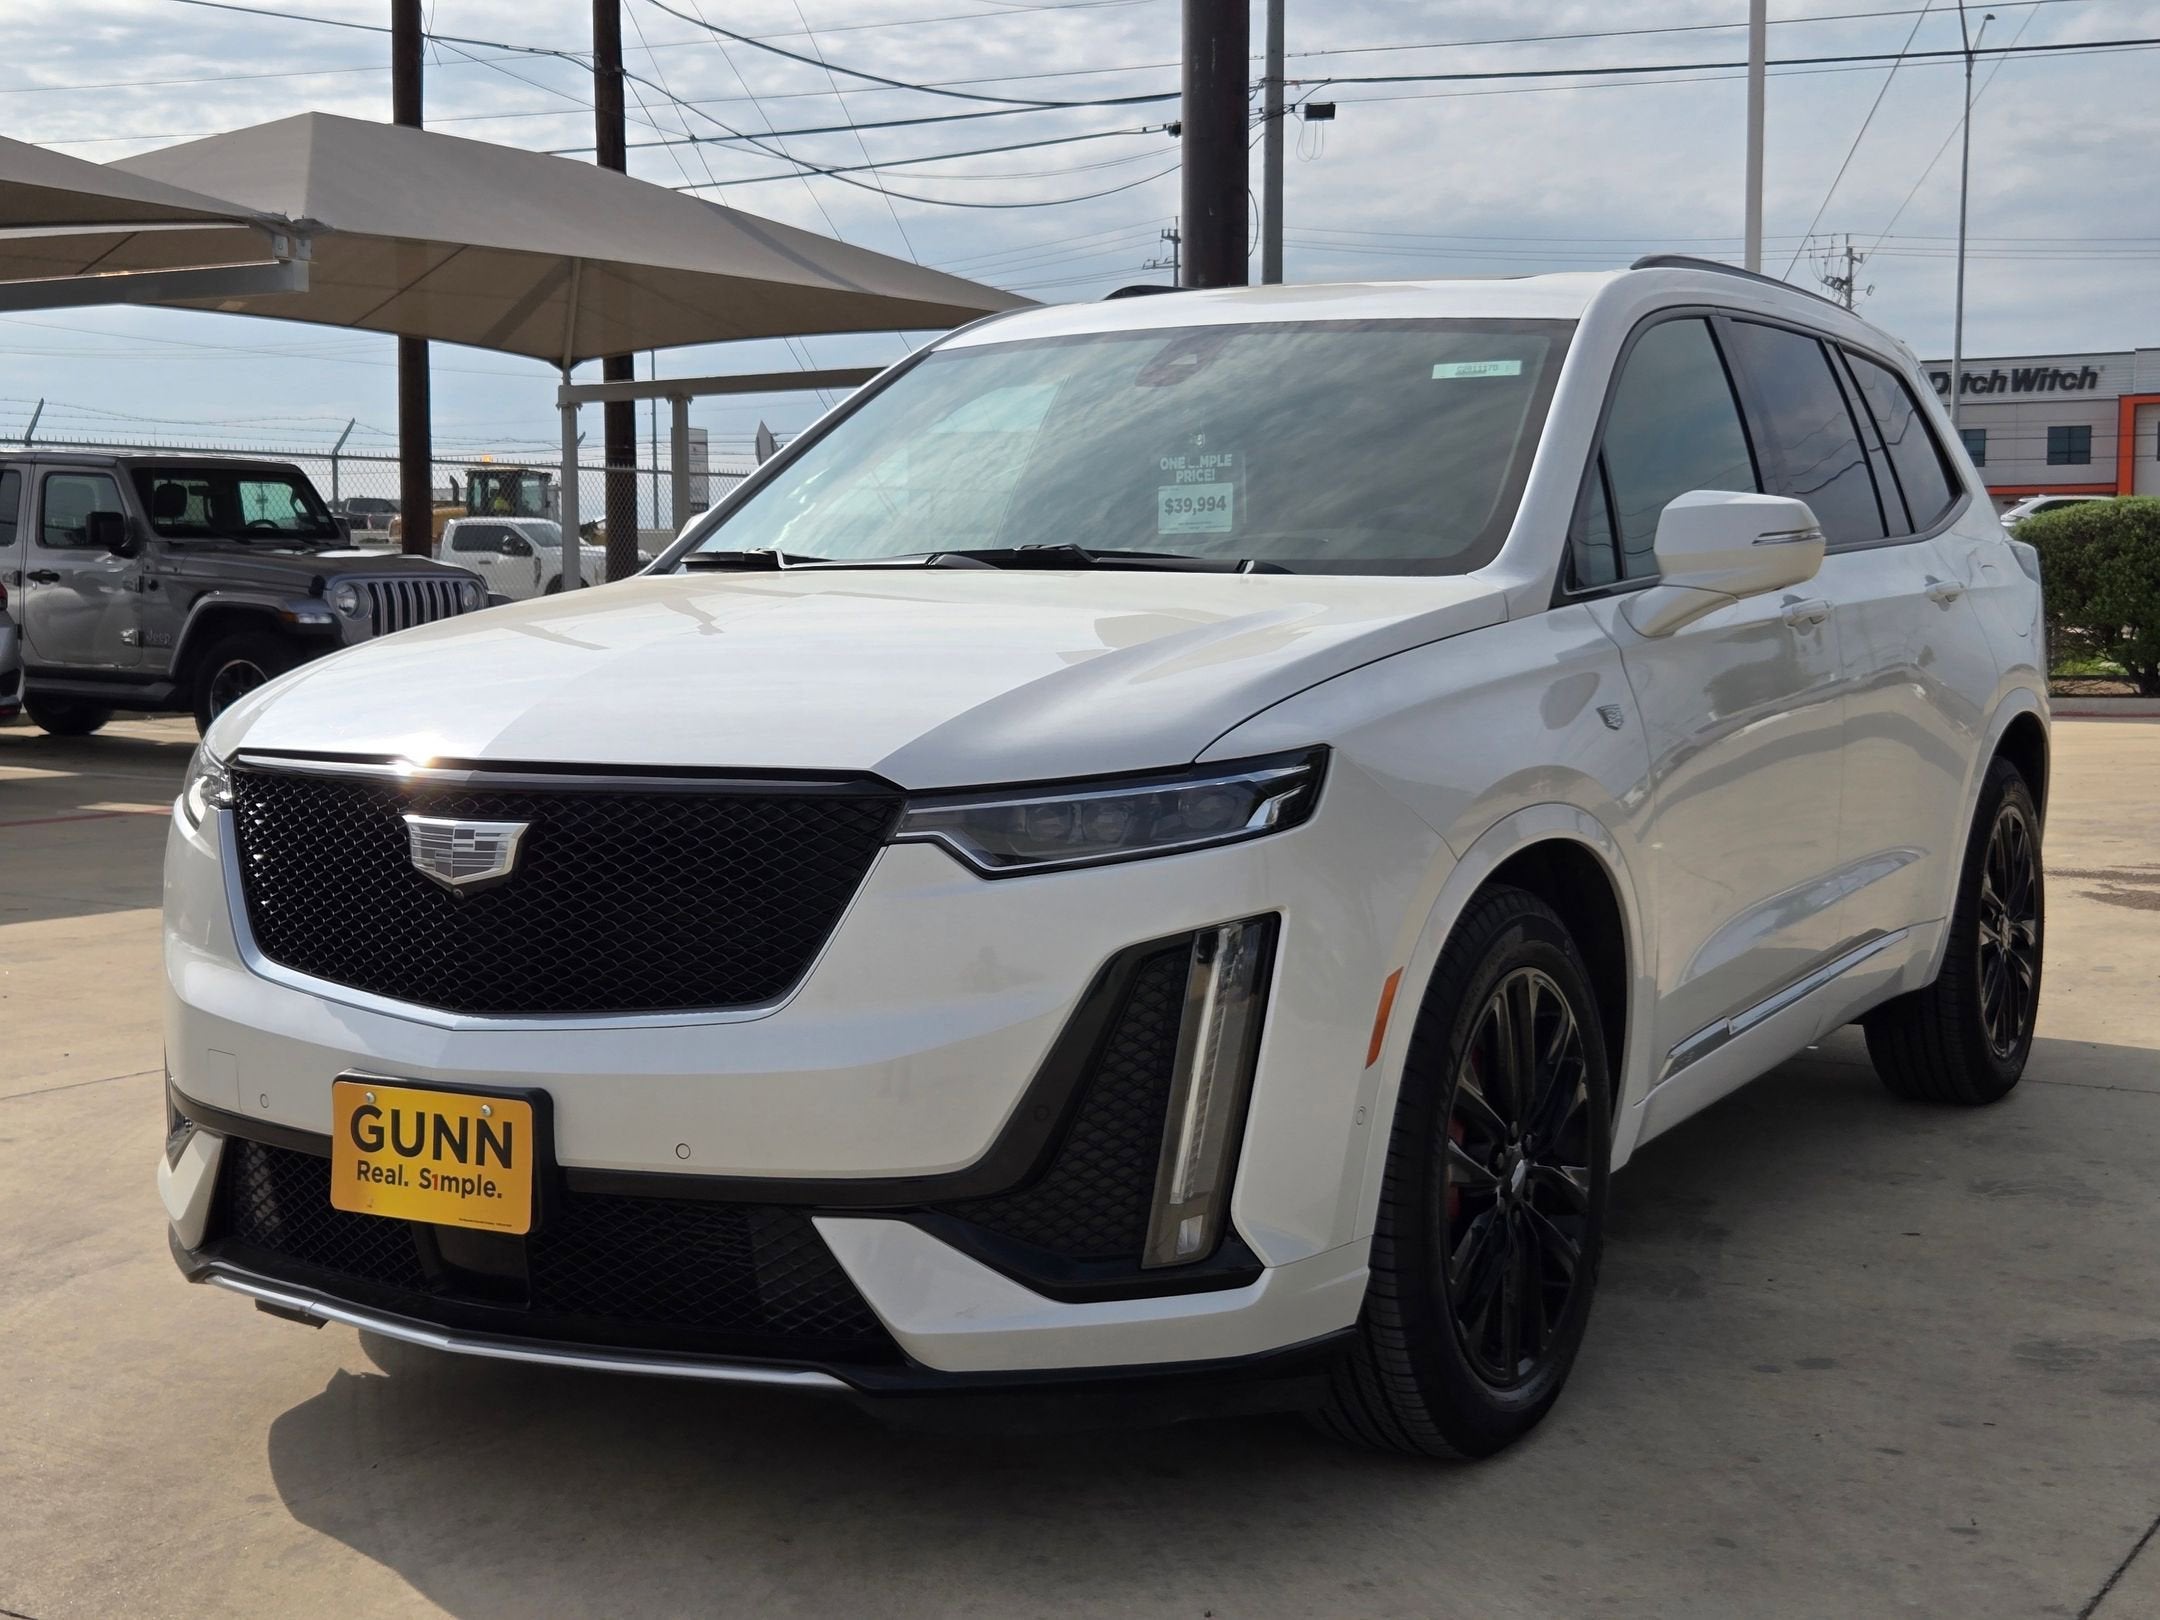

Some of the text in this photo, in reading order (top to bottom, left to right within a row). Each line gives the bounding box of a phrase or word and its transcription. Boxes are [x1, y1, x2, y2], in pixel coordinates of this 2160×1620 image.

[1929, 365, 2098, 395] Dtch Witch
[1160, 456, 1186, 471] ONE
[1175, 468, 1216, 483] PRICE!
[1164, 495, 1227, 516] $39,994
[145, 628, 171, 645] Jeep
[350, 1104, 512, 1169] GUNN
[356, 1160, 409, 1187] Real.
